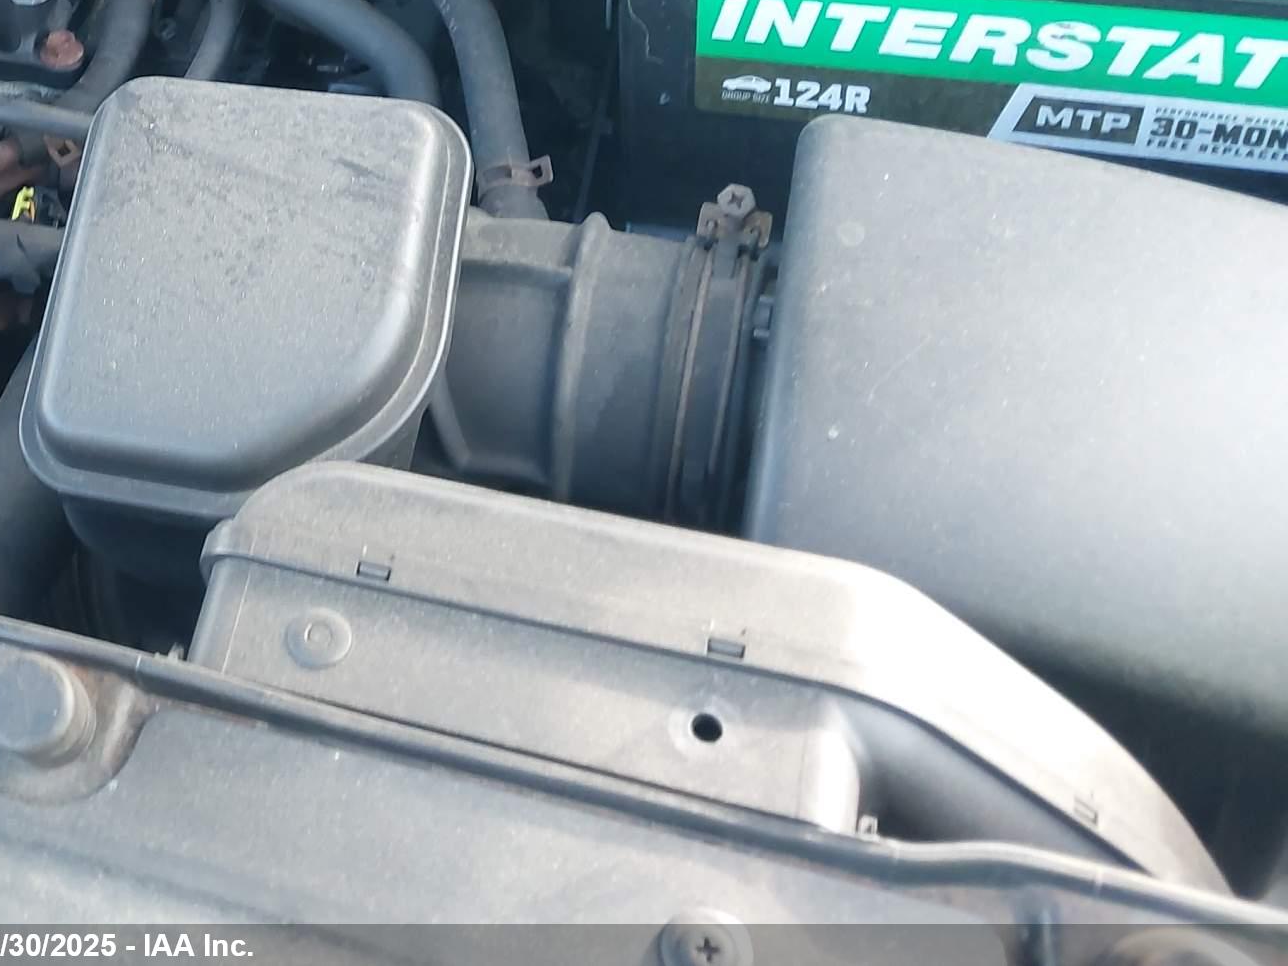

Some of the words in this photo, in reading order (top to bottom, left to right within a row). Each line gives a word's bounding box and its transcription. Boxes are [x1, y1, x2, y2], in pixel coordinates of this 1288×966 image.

[773, 77, 872, 114] 124R
[1035, 104, 1132, 135] MTP
[1146, 138, 1189, 151] FREE
